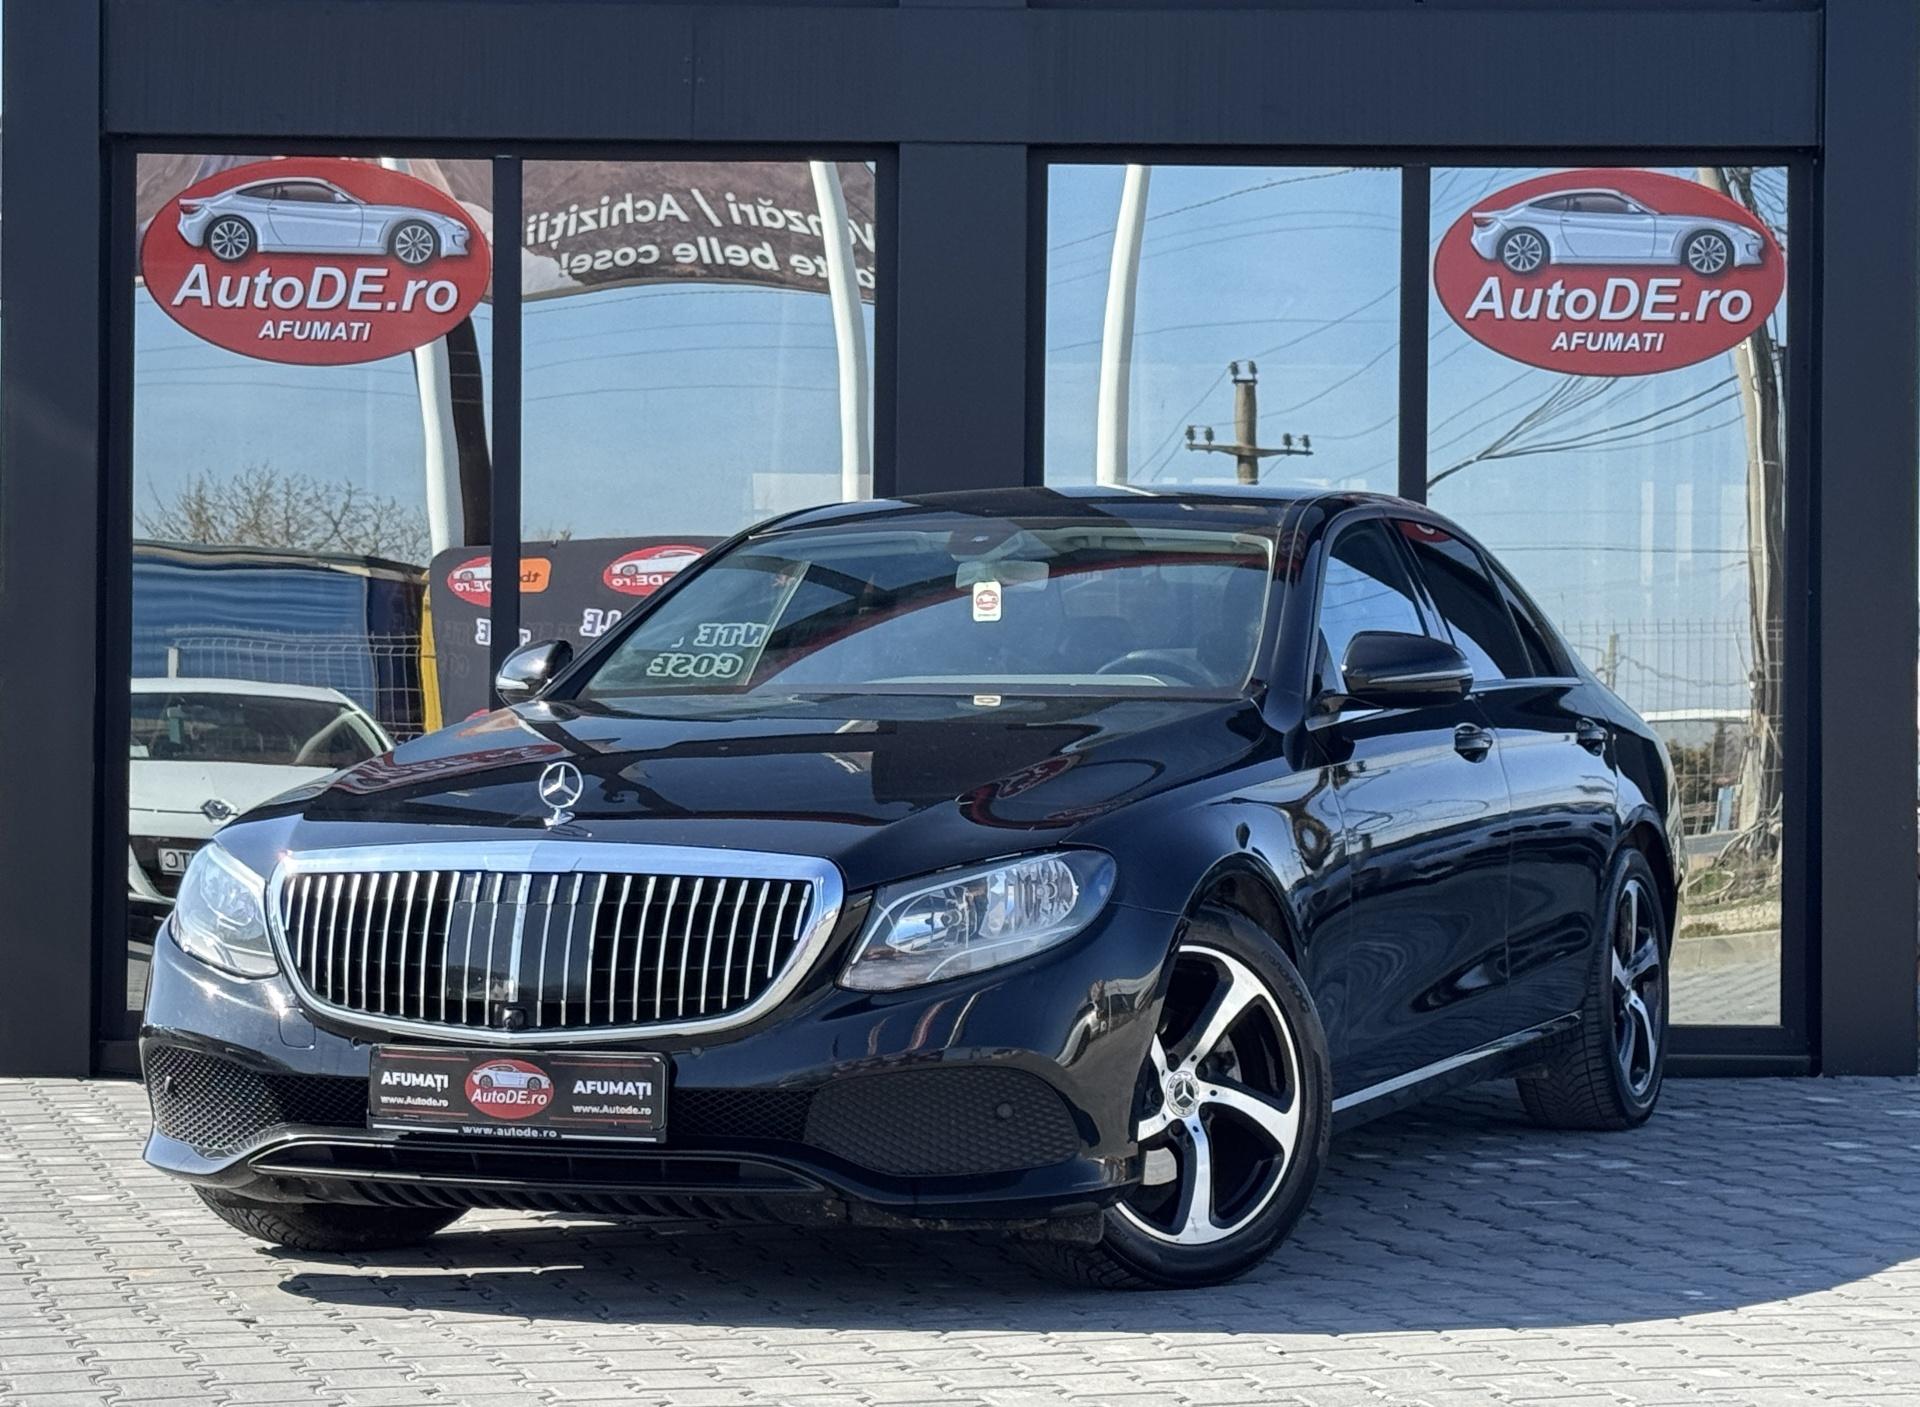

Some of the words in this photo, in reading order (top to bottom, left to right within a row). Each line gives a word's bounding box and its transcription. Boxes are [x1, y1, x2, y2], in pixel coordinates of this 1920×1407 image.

[171, 263, 459, 313] AutoDE.ro
[1465, 276, 1753, 323] AutoDE.ro
[258, 320, 371, 342] AFUMATI
[1551, 332, 1664, 352] AFUMATI
[471, 1088, 548, 1106] AutoDE.ro
[462, 1125, 557, 1138] www.autode.ro
